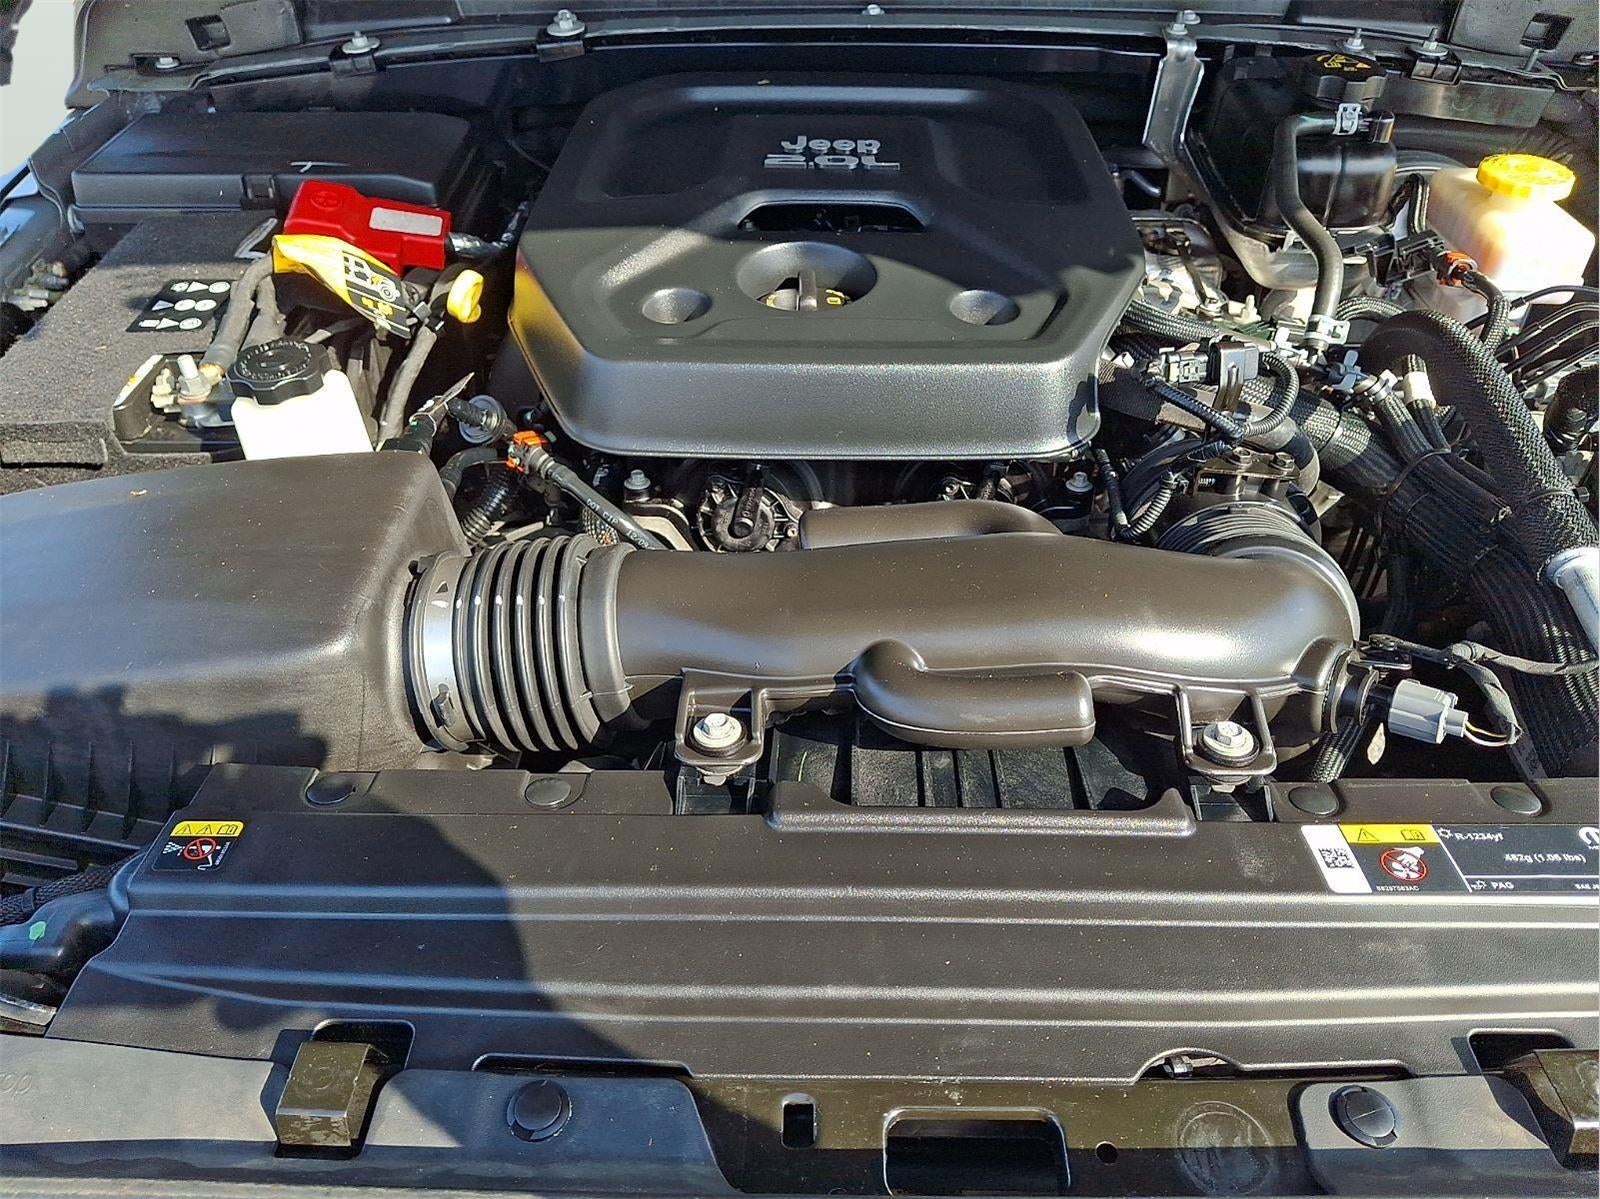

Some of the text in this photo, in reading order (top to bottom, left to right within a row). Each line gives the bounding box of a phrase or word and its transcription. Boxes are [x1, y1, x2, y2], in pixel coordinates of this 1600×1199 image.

[780, 135, 881, 154] Jeep
[764, 154, 900, 170] 2.0L
[1454, 831, 1504, 843] R-1234yf
[1564, 853, 1586, 863] lbs)
[1490, 881, 1514, 890] PAG
